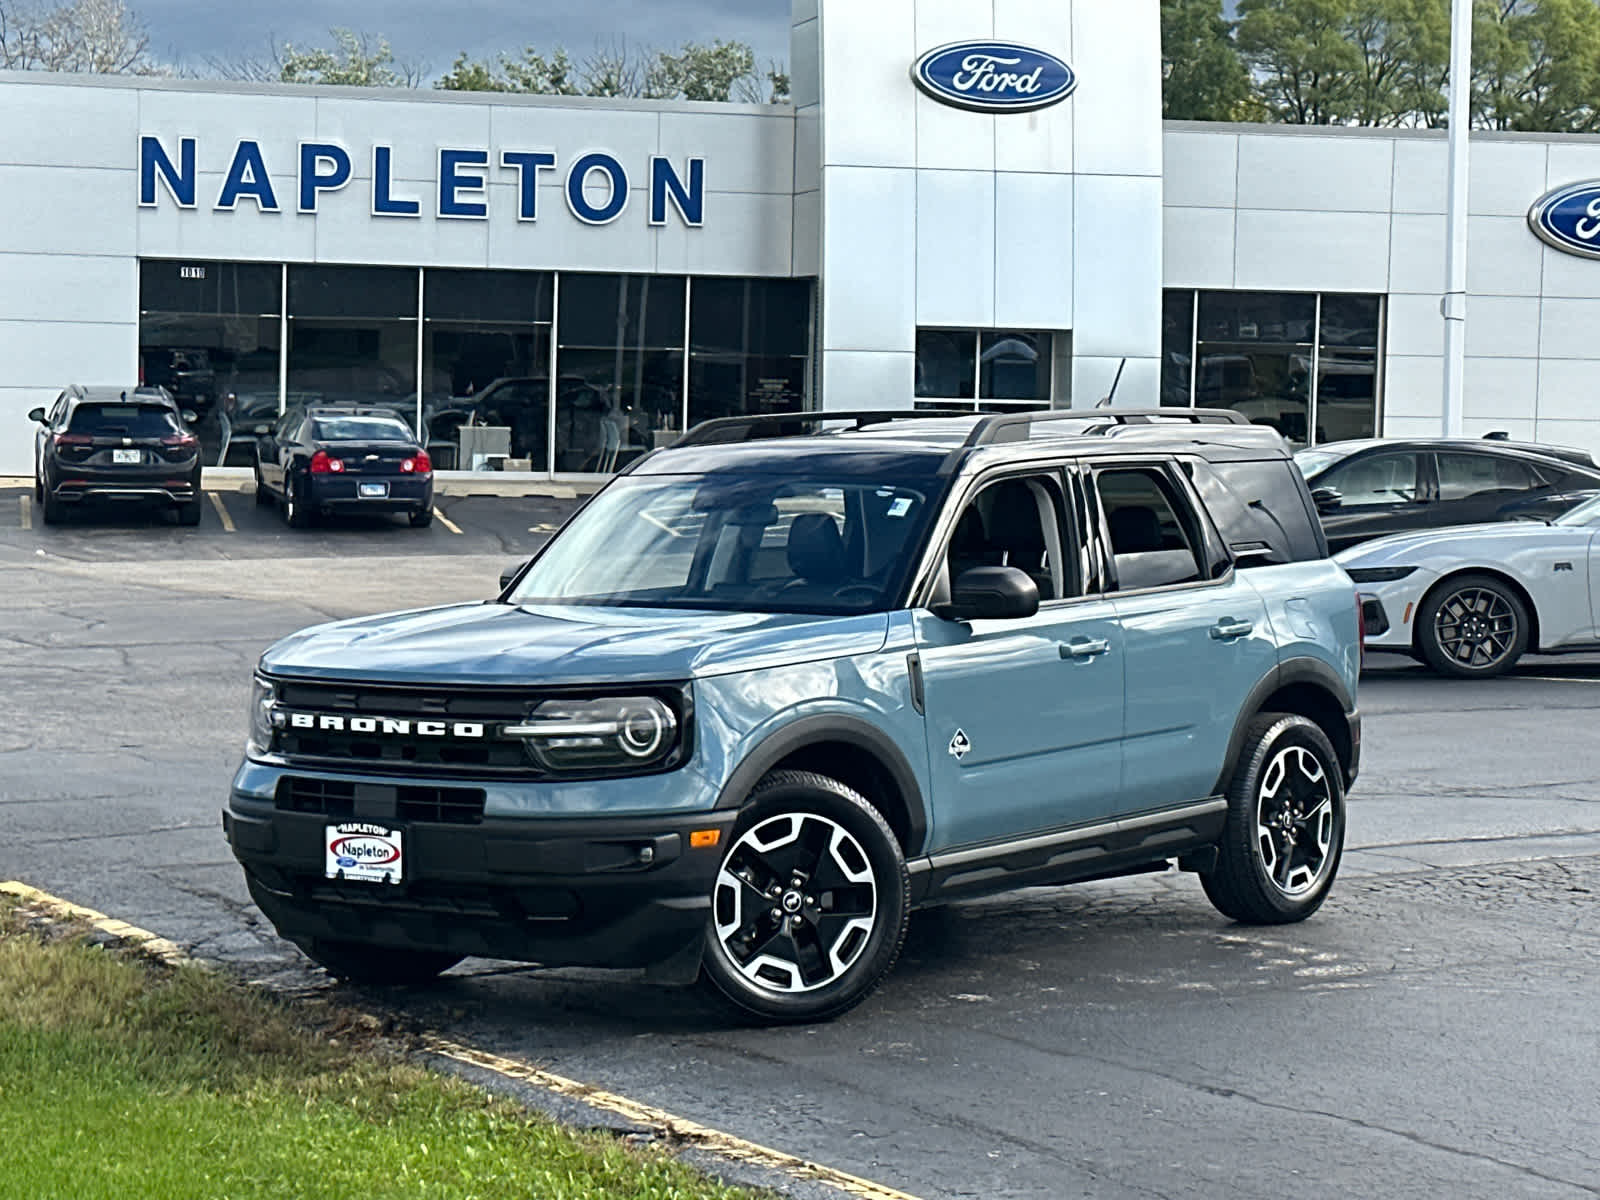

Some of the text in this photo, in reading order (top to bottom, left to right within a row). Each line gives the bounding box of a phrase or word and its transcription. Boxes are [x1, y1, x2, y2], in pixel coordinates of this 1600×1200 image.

[953, 54, 1044, 94] Ford
[138, 133, 705, 228] NAPLETON
[291, 713, 484, 737] BRONCO
[340, 823, 388, 836] NAPLETON
[342, 842, 390, 859] Napleton
